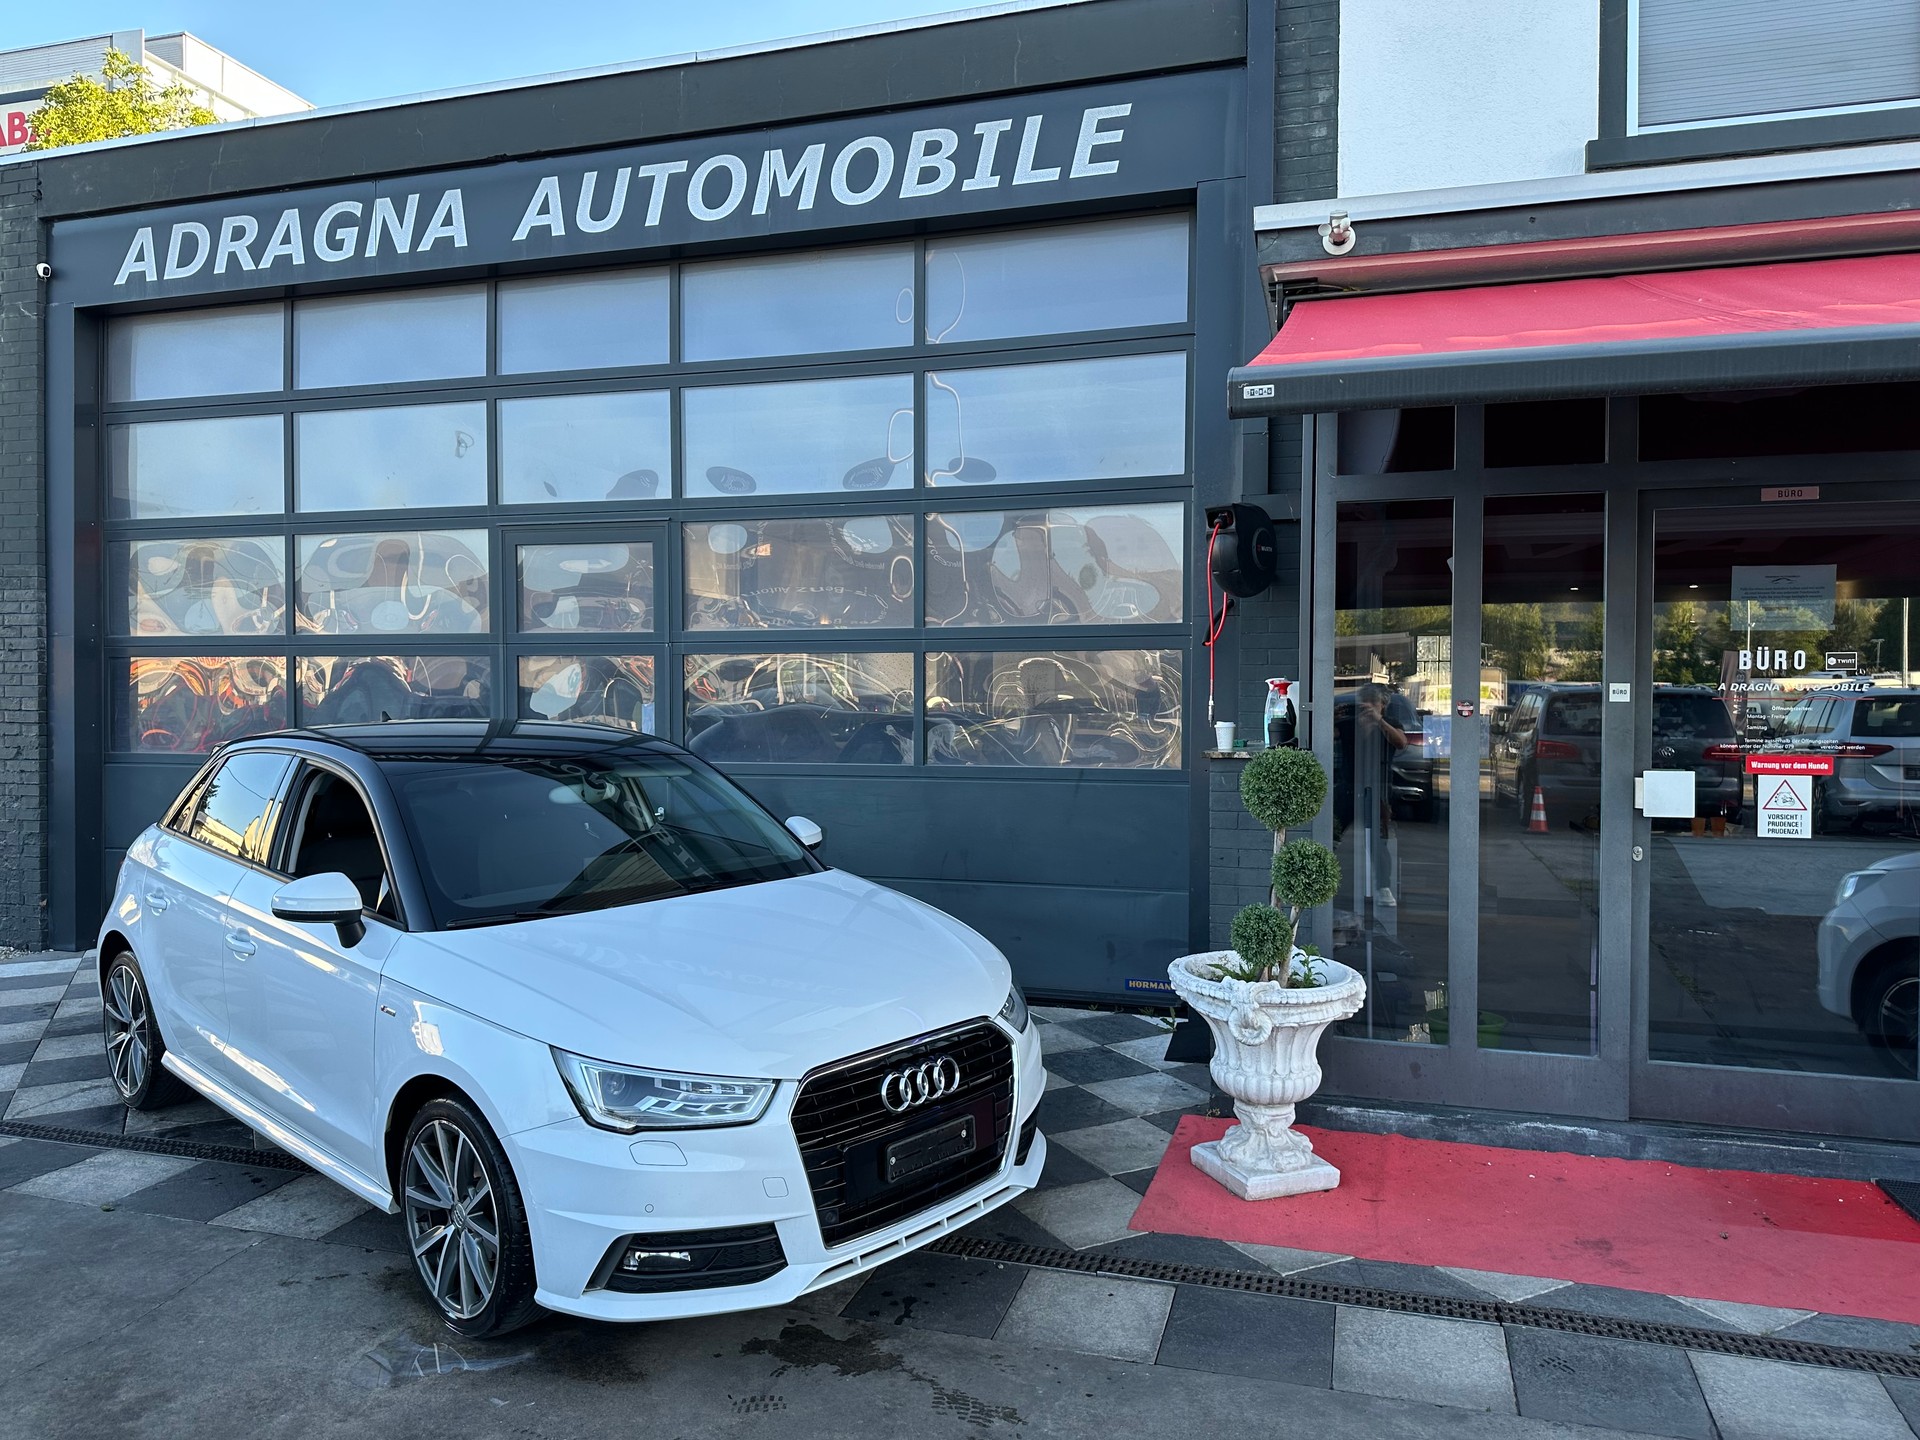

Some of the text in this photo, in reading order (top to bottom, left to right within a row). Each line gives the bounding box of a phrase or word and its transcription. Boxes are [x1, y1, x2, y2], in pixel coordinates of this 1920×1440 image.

[113, 102, 1132, 286] ADRAGNA AUTOMOBILE
[1777, 489, 1803, 498] BÜRO
[1739, 646, 1806, 670] BÜRO
[1751, 761, 1780, 770] Warnung
[1793, 762, 1807, 770] dem
[1808, 762, 1829, 770] Hunde
